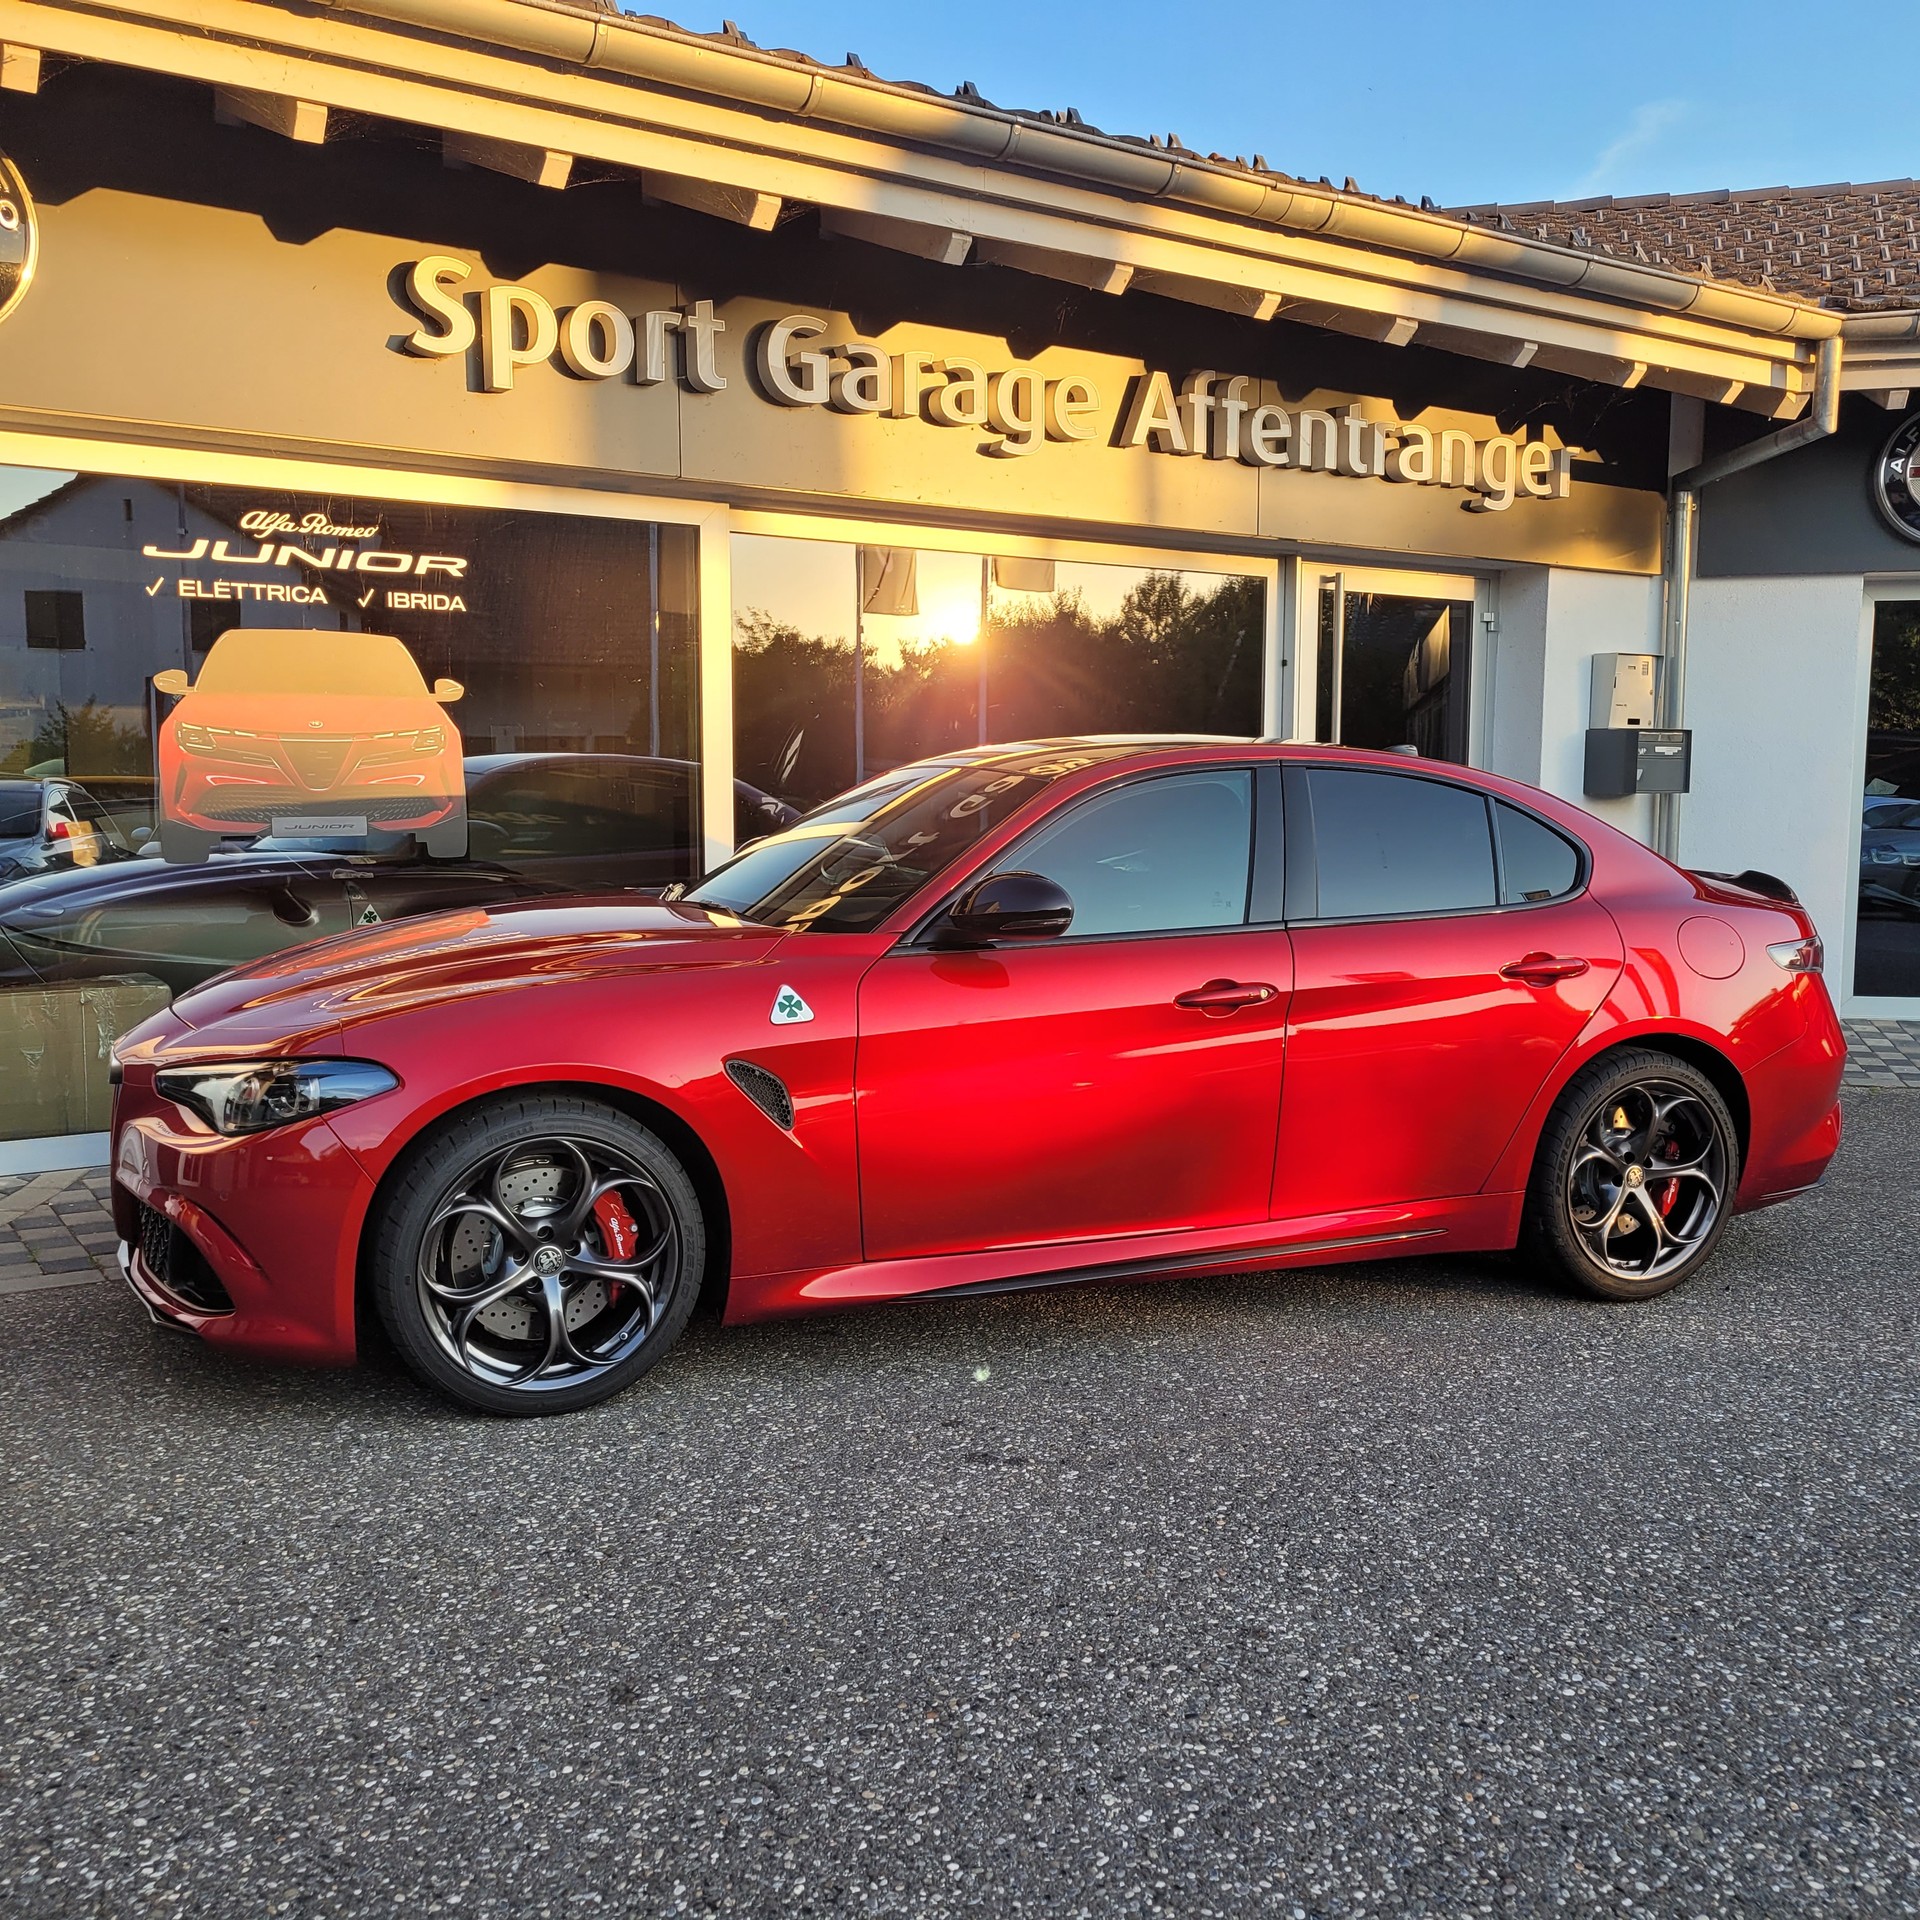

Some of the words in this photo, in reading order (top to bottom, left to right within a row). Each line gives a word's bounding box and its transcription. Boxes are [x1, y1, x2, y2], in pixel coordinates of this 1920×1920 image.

[405, 255, 728, 393] Sport
[757, 314, 1101, 457] Garage
[1121, 369, 1582, 511] Affentranger
[240, 511, 299, 539] Alfa
[298, 513, 380, 538] Romeo
[143, 539, 468, 577] JUNIOR
[178, 579, 328, 605] ELETTRICA
[387, 591, 467, 612] IBRIDA
